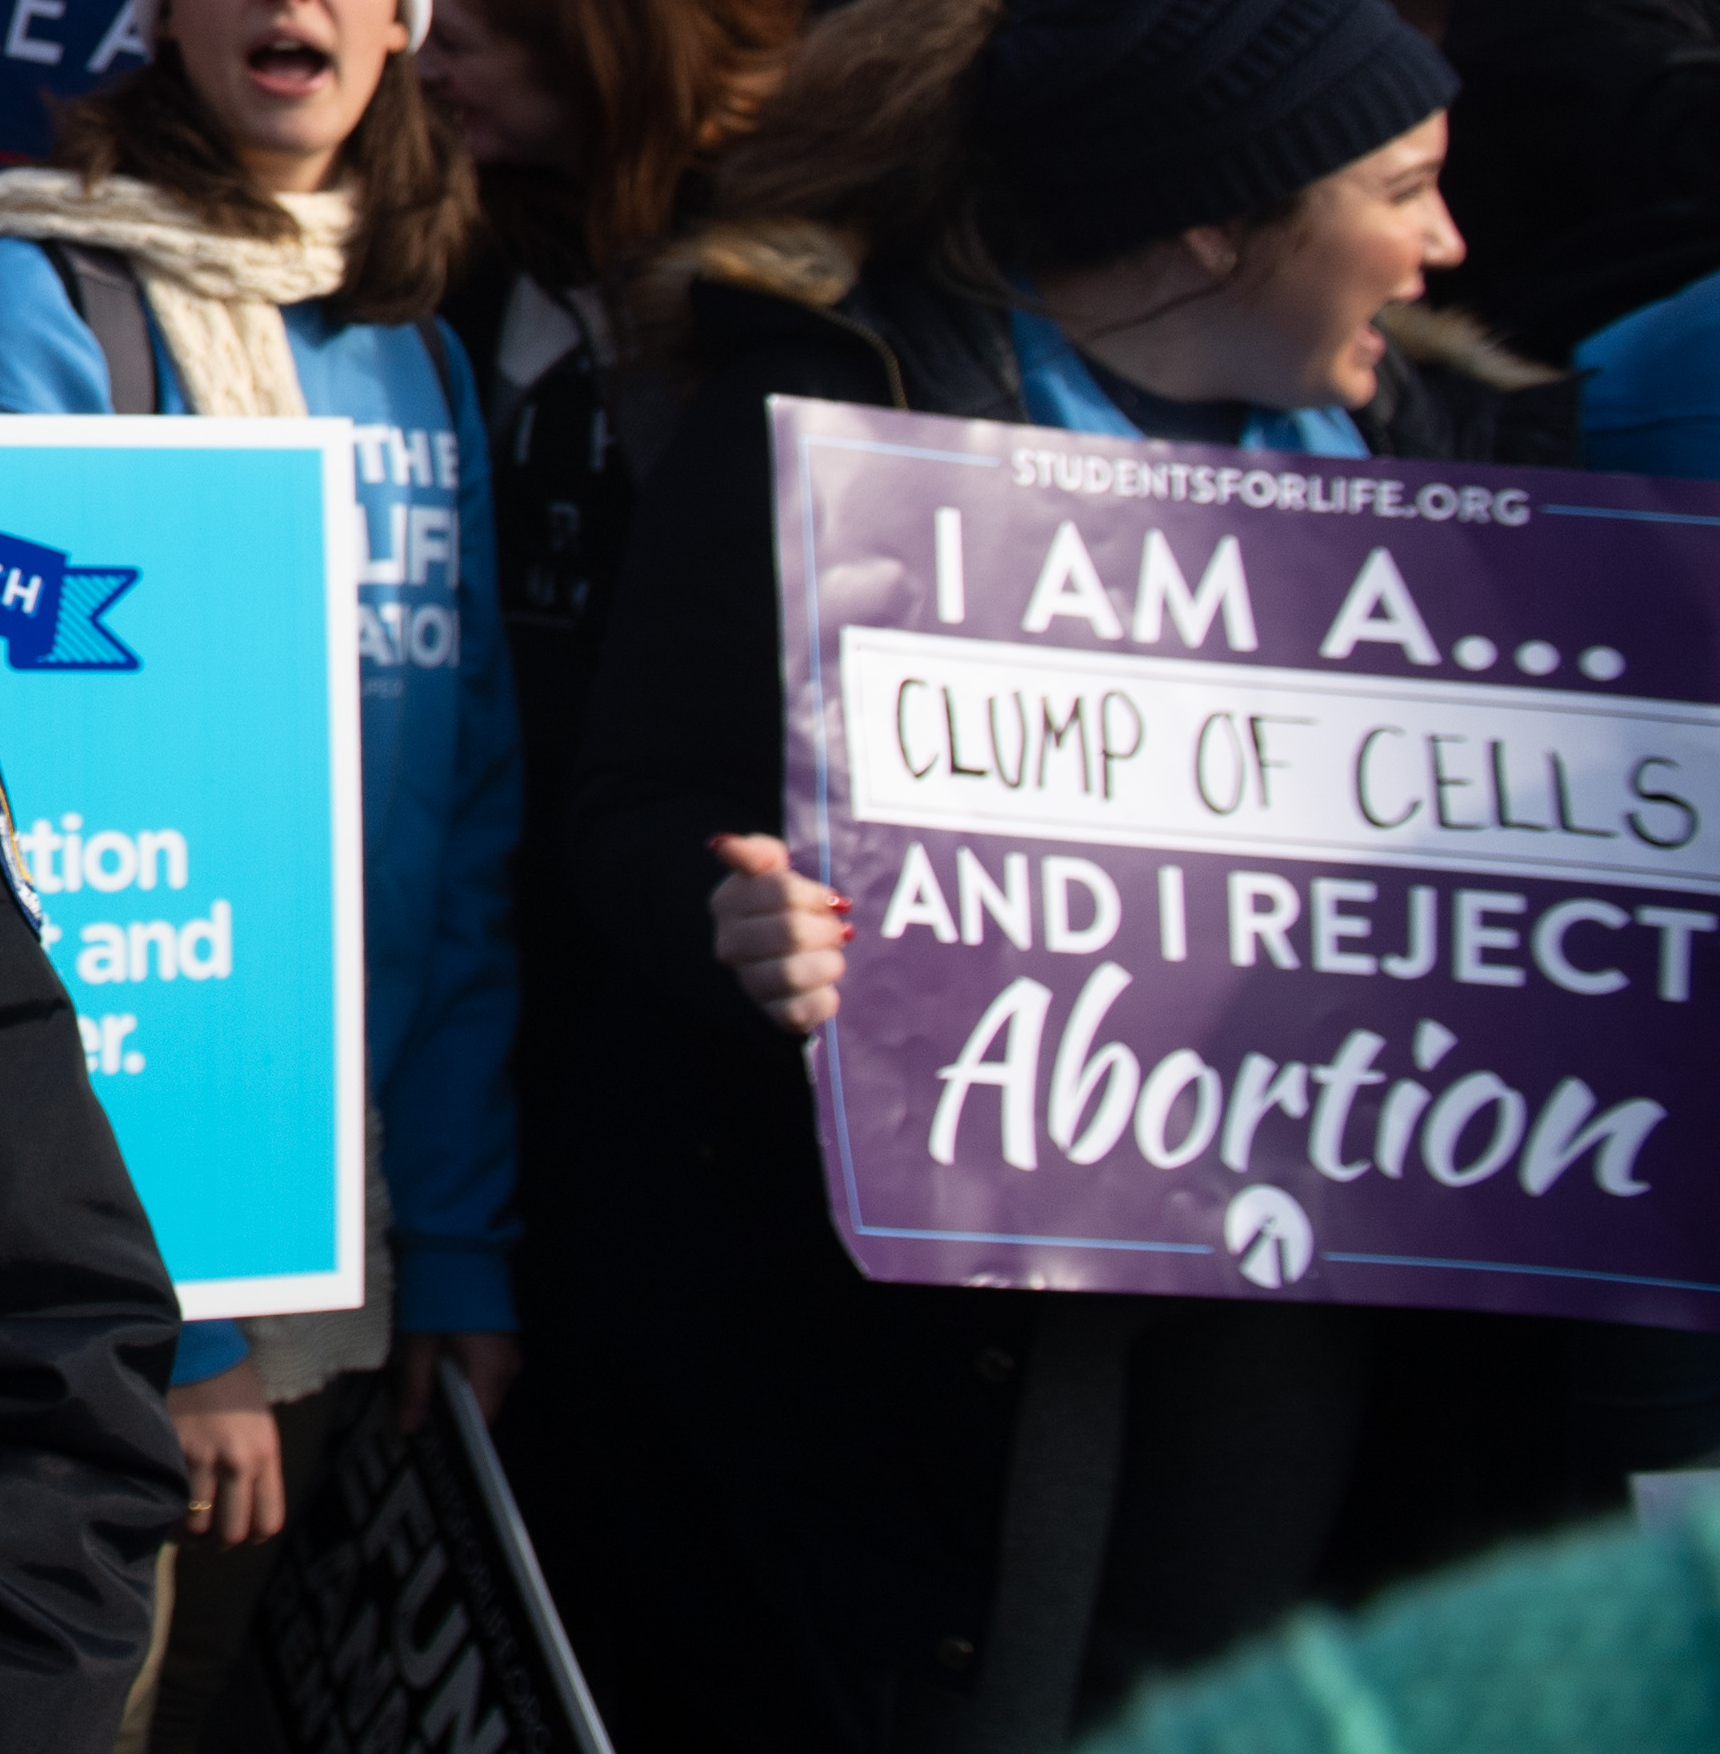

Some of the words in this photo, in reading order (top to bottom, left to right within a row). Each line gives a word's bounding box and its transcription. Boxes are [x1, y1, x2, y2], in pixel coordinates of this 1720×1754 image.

[1011, 448, 1532, 527] STUDENTSFORLIFE.ORG
[934, 506, 965, 624] I
[1022, 520, 1260, 653] AM
[1319, 545, 1627, 683] A...
[895, 676, 1145, 803] CLUMP
[1194, 712, 1320, 817] OF
[1356, 725, 1700, 851] CELLS
[77, 898, 233, 983] and
[881, 842, 1122, 955] AND
[1161, 866, 1187, 962] I
[1229, 869, 1720, 1004] REJECT
[928, 961, 1668, 1197] Abortion
